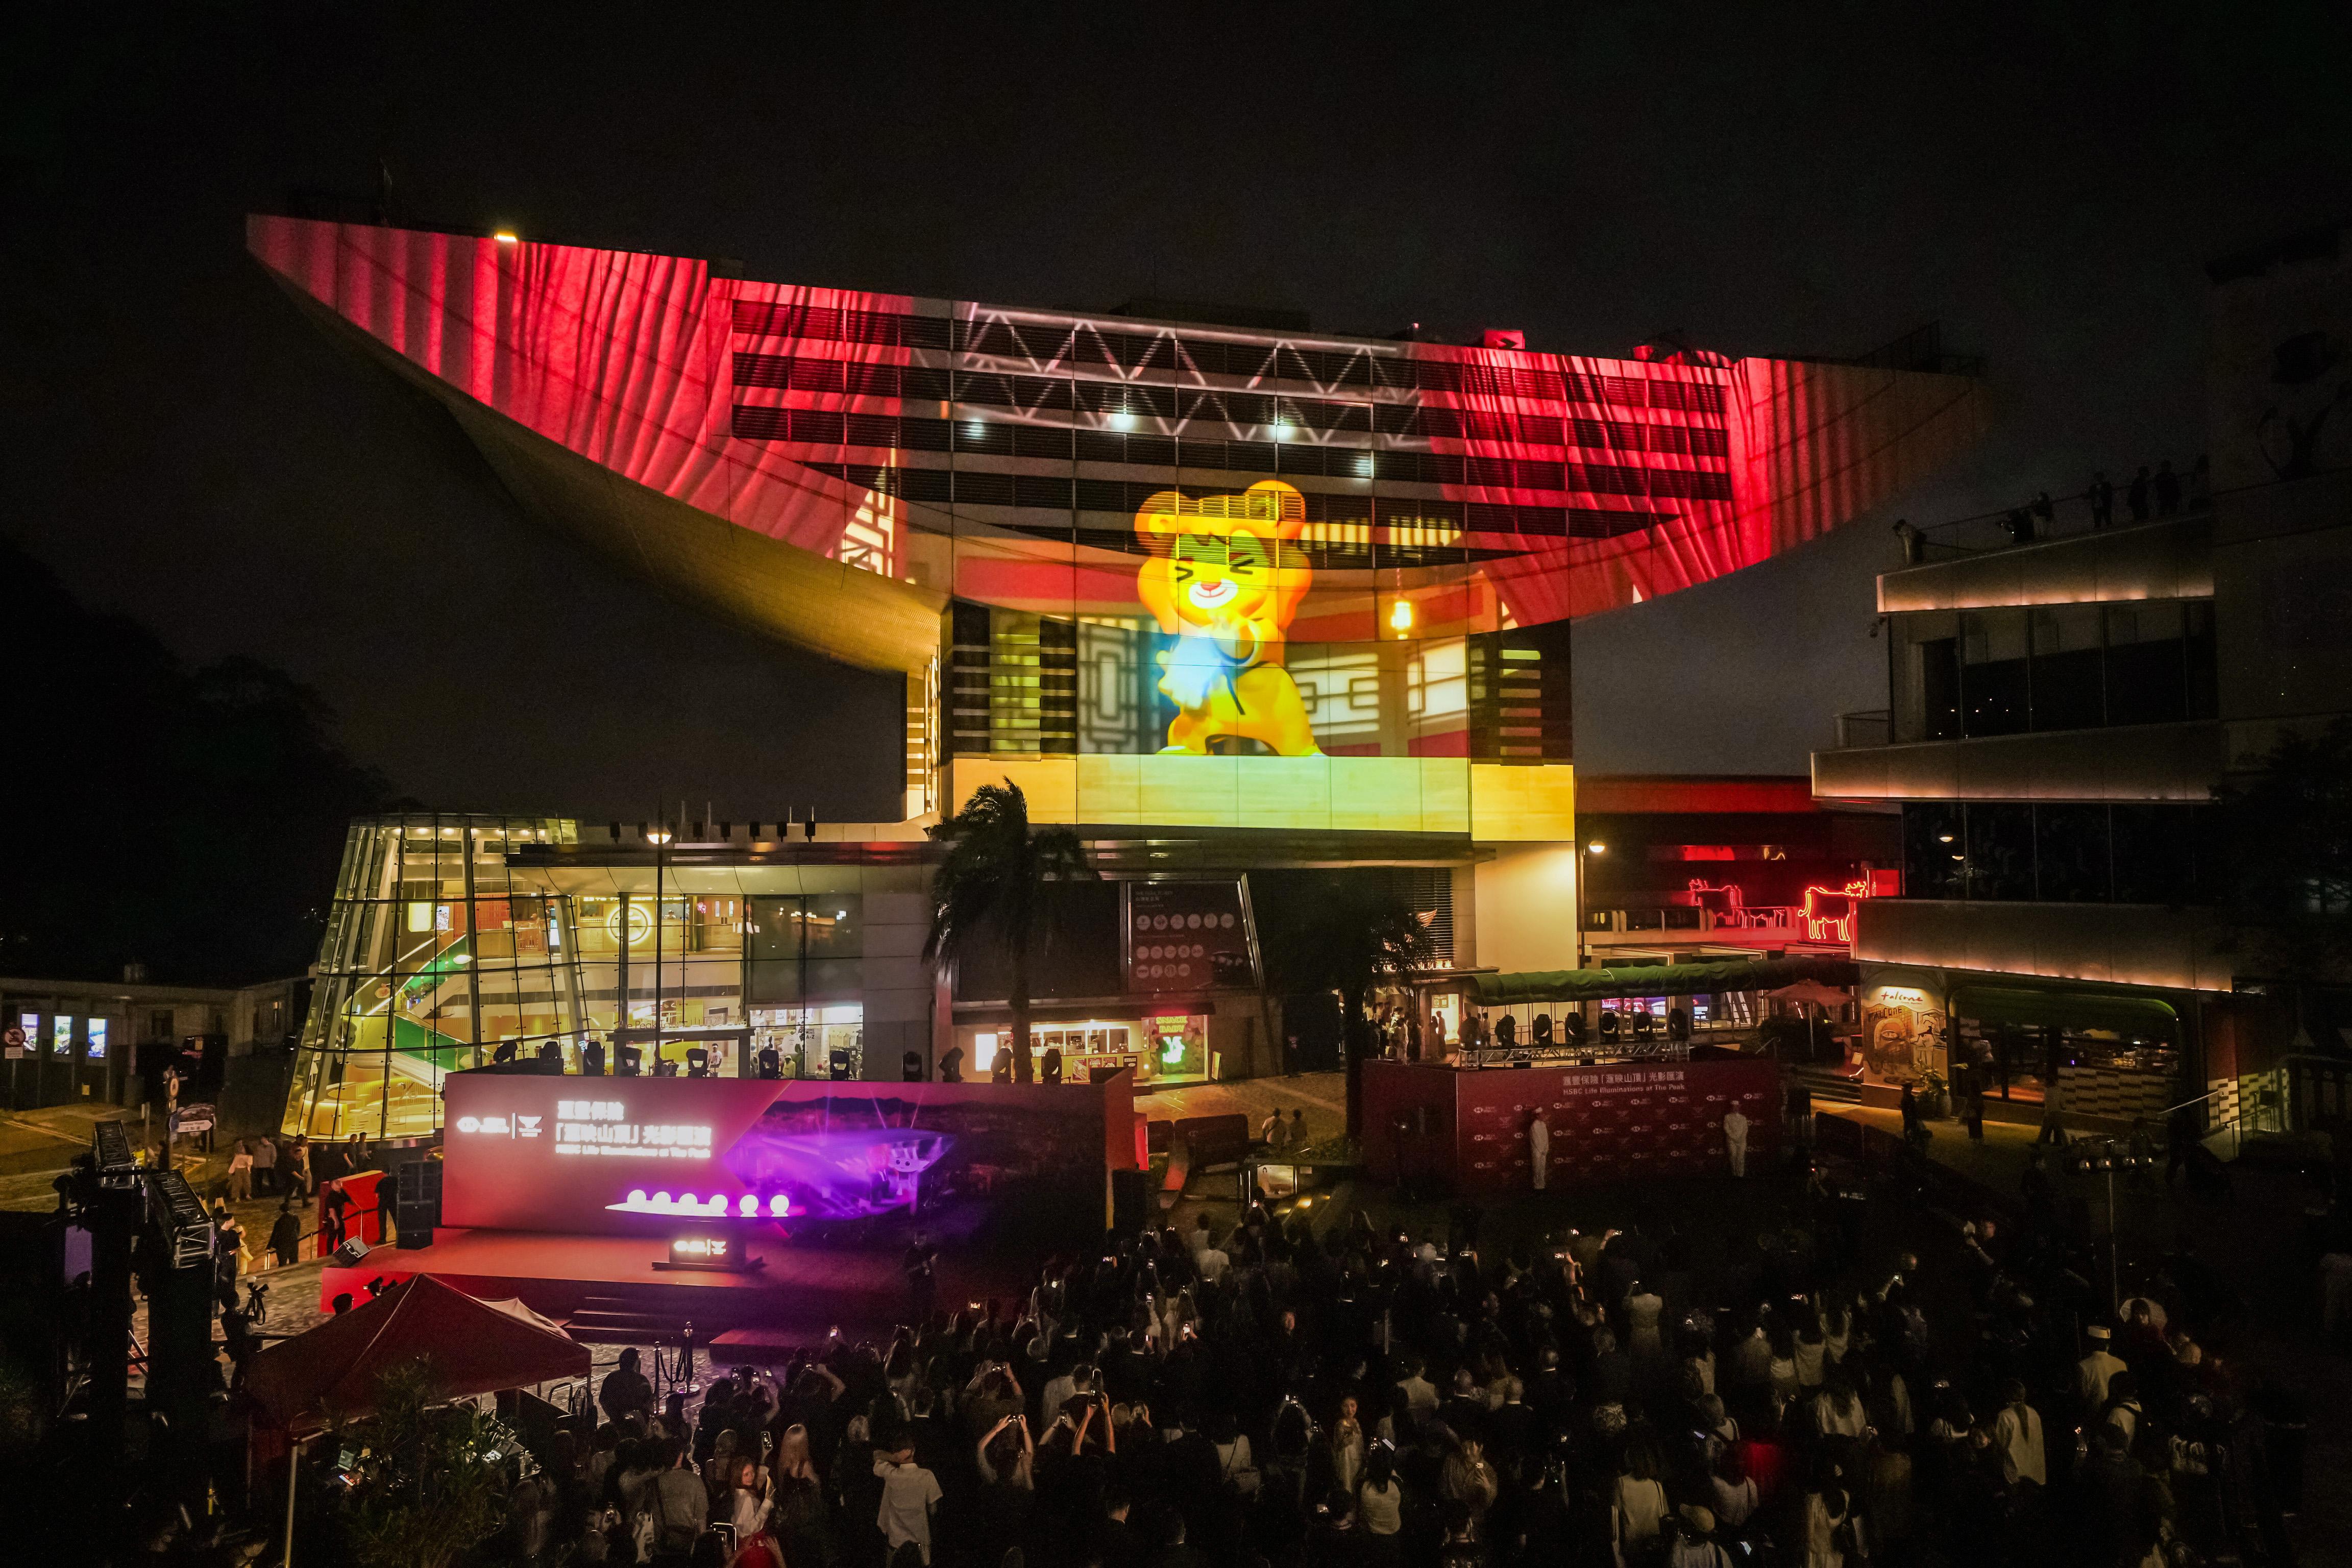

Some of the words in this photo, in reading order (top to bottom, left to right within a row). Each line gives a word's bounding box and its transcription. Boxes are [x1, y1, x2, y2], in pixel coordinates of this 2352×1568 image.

[1156, 1016, 1188, 1024] SNACK
[1159, 1025, 1184, 1033] BABY
[1600, 1085, 1644, 1093] Illuminations
